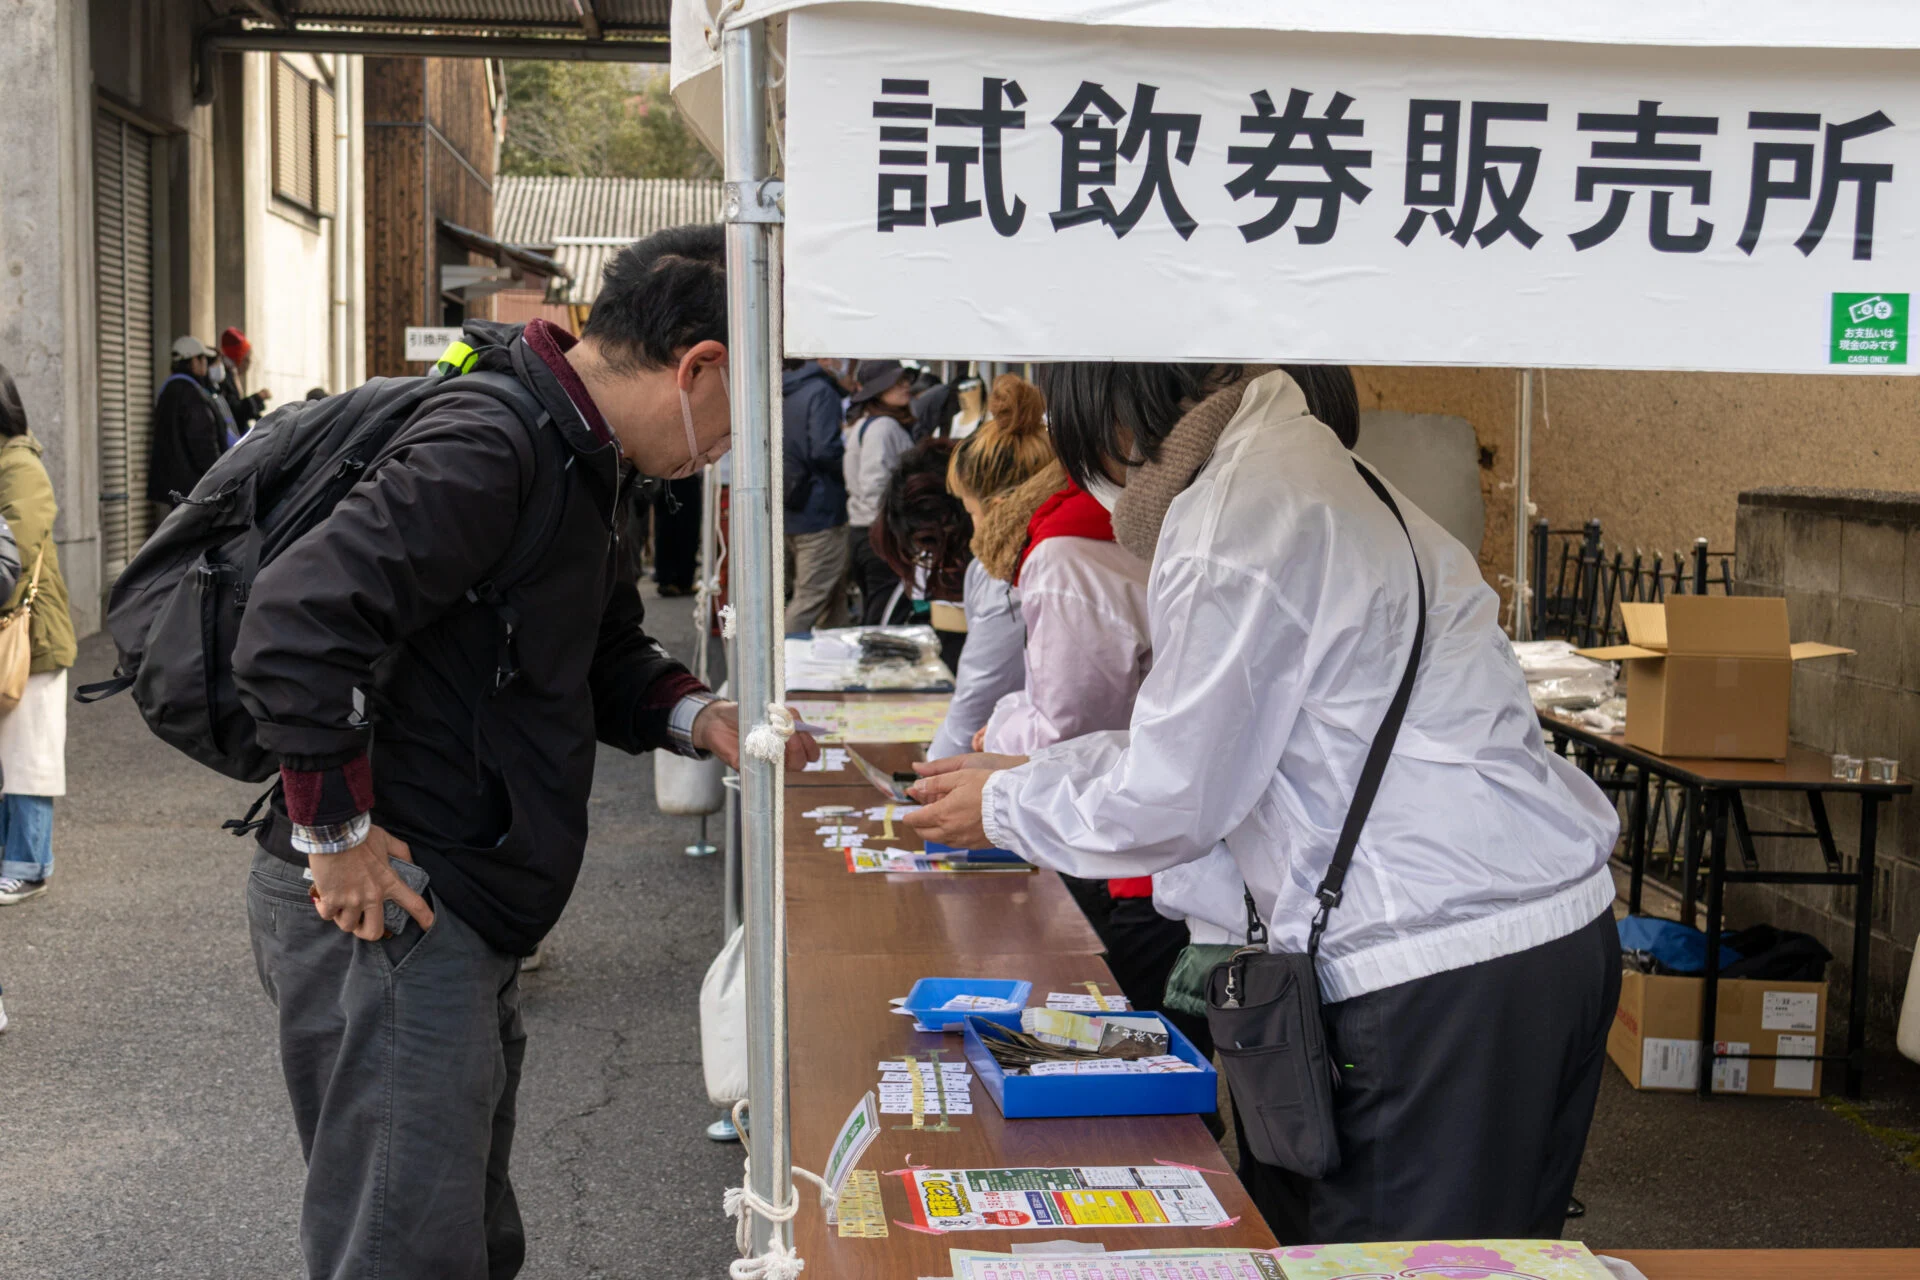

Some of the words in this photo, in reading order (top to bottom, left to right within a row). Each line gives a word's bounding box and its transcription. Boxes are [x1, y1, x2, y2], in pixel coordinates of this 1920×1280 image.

[872, 76, 1895, 261] 試飲券販売所
[1844, 328, 1894, 339] お支払いは
[1839, 339, 1898, 351] 現金のみです
[1848, 355, 1868, 363] CASH
[1870, 355, 1889, 363] ONLY
